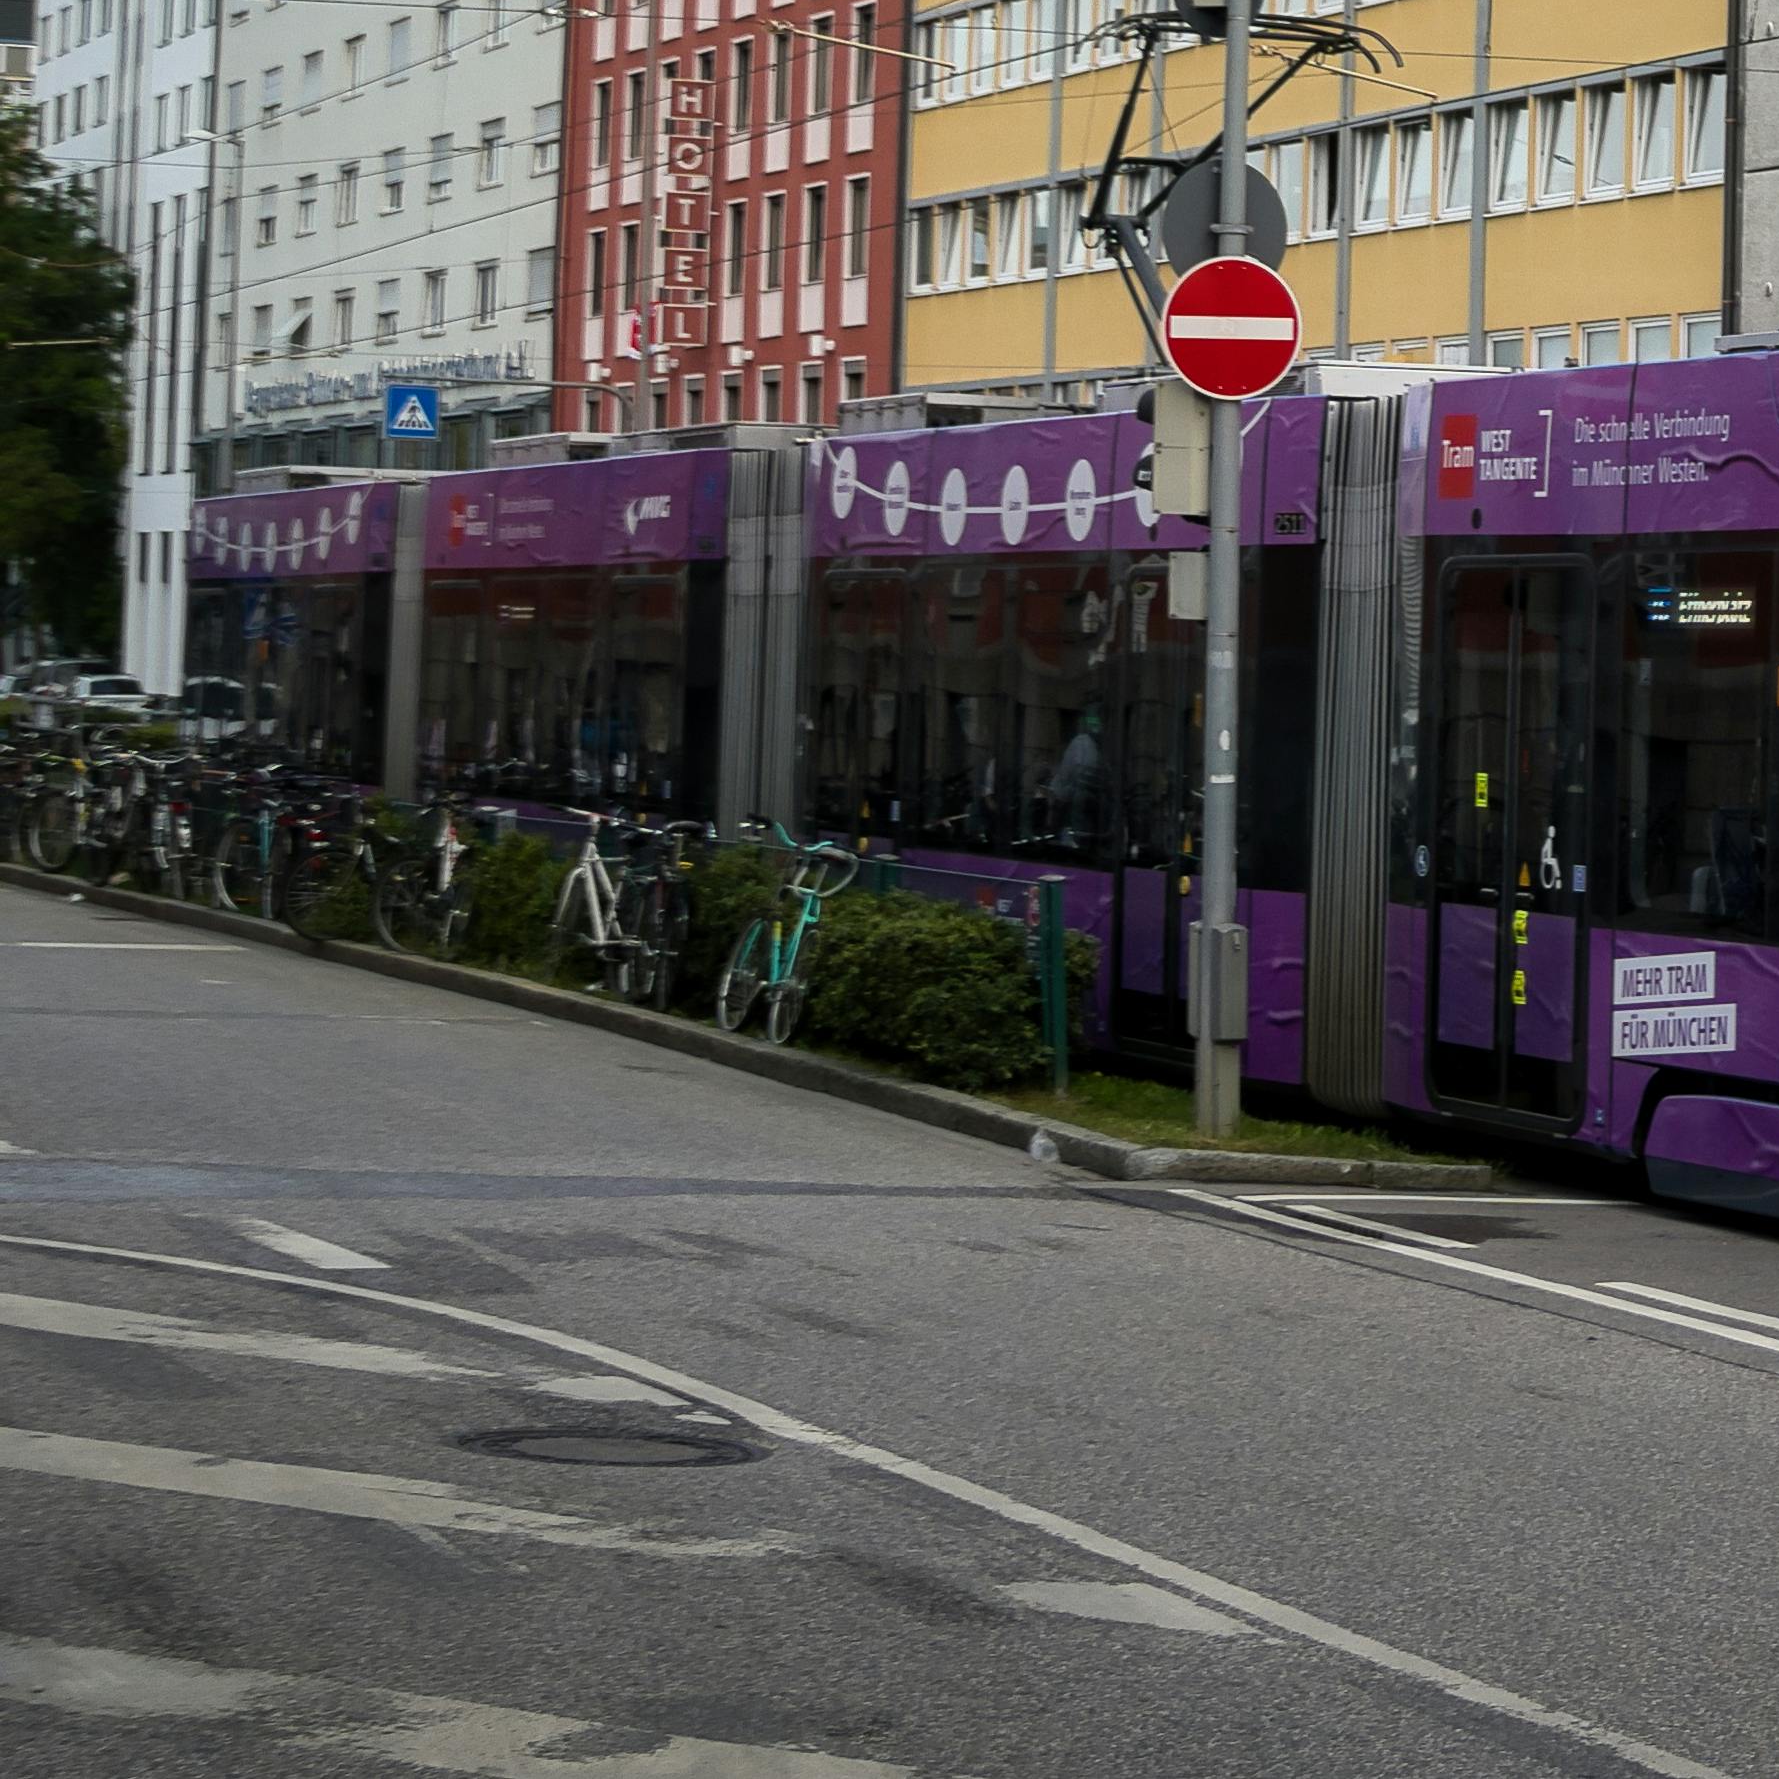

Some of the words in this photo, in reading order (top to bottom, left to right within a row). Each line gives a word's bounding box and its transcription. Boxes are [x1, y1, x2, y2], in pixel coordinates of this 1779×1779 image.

[674, 84, 704, 340] HOTEL
[1481, 429, 1513, 453] WEST
[1574, 415, 1595, 444] Die
[1653, 407, 1731, 442] Verbindung
[1442, 438, 1475, 469] Tram
[1480, 456, 1538, 481] TANGENTE
[1572, 459, 1589, 487] im
[1658, 456, 1710, 483] Westen.
[1275, 514, 1306, 535] 2511
[1621, 967, 1663, 998] MEHR
[1667, 963, 1708, 995] TRAM
[1620, 1013, 1649, 1050] FÜR
[1652, 1010, 1729, 1049] MÜNCHEN
